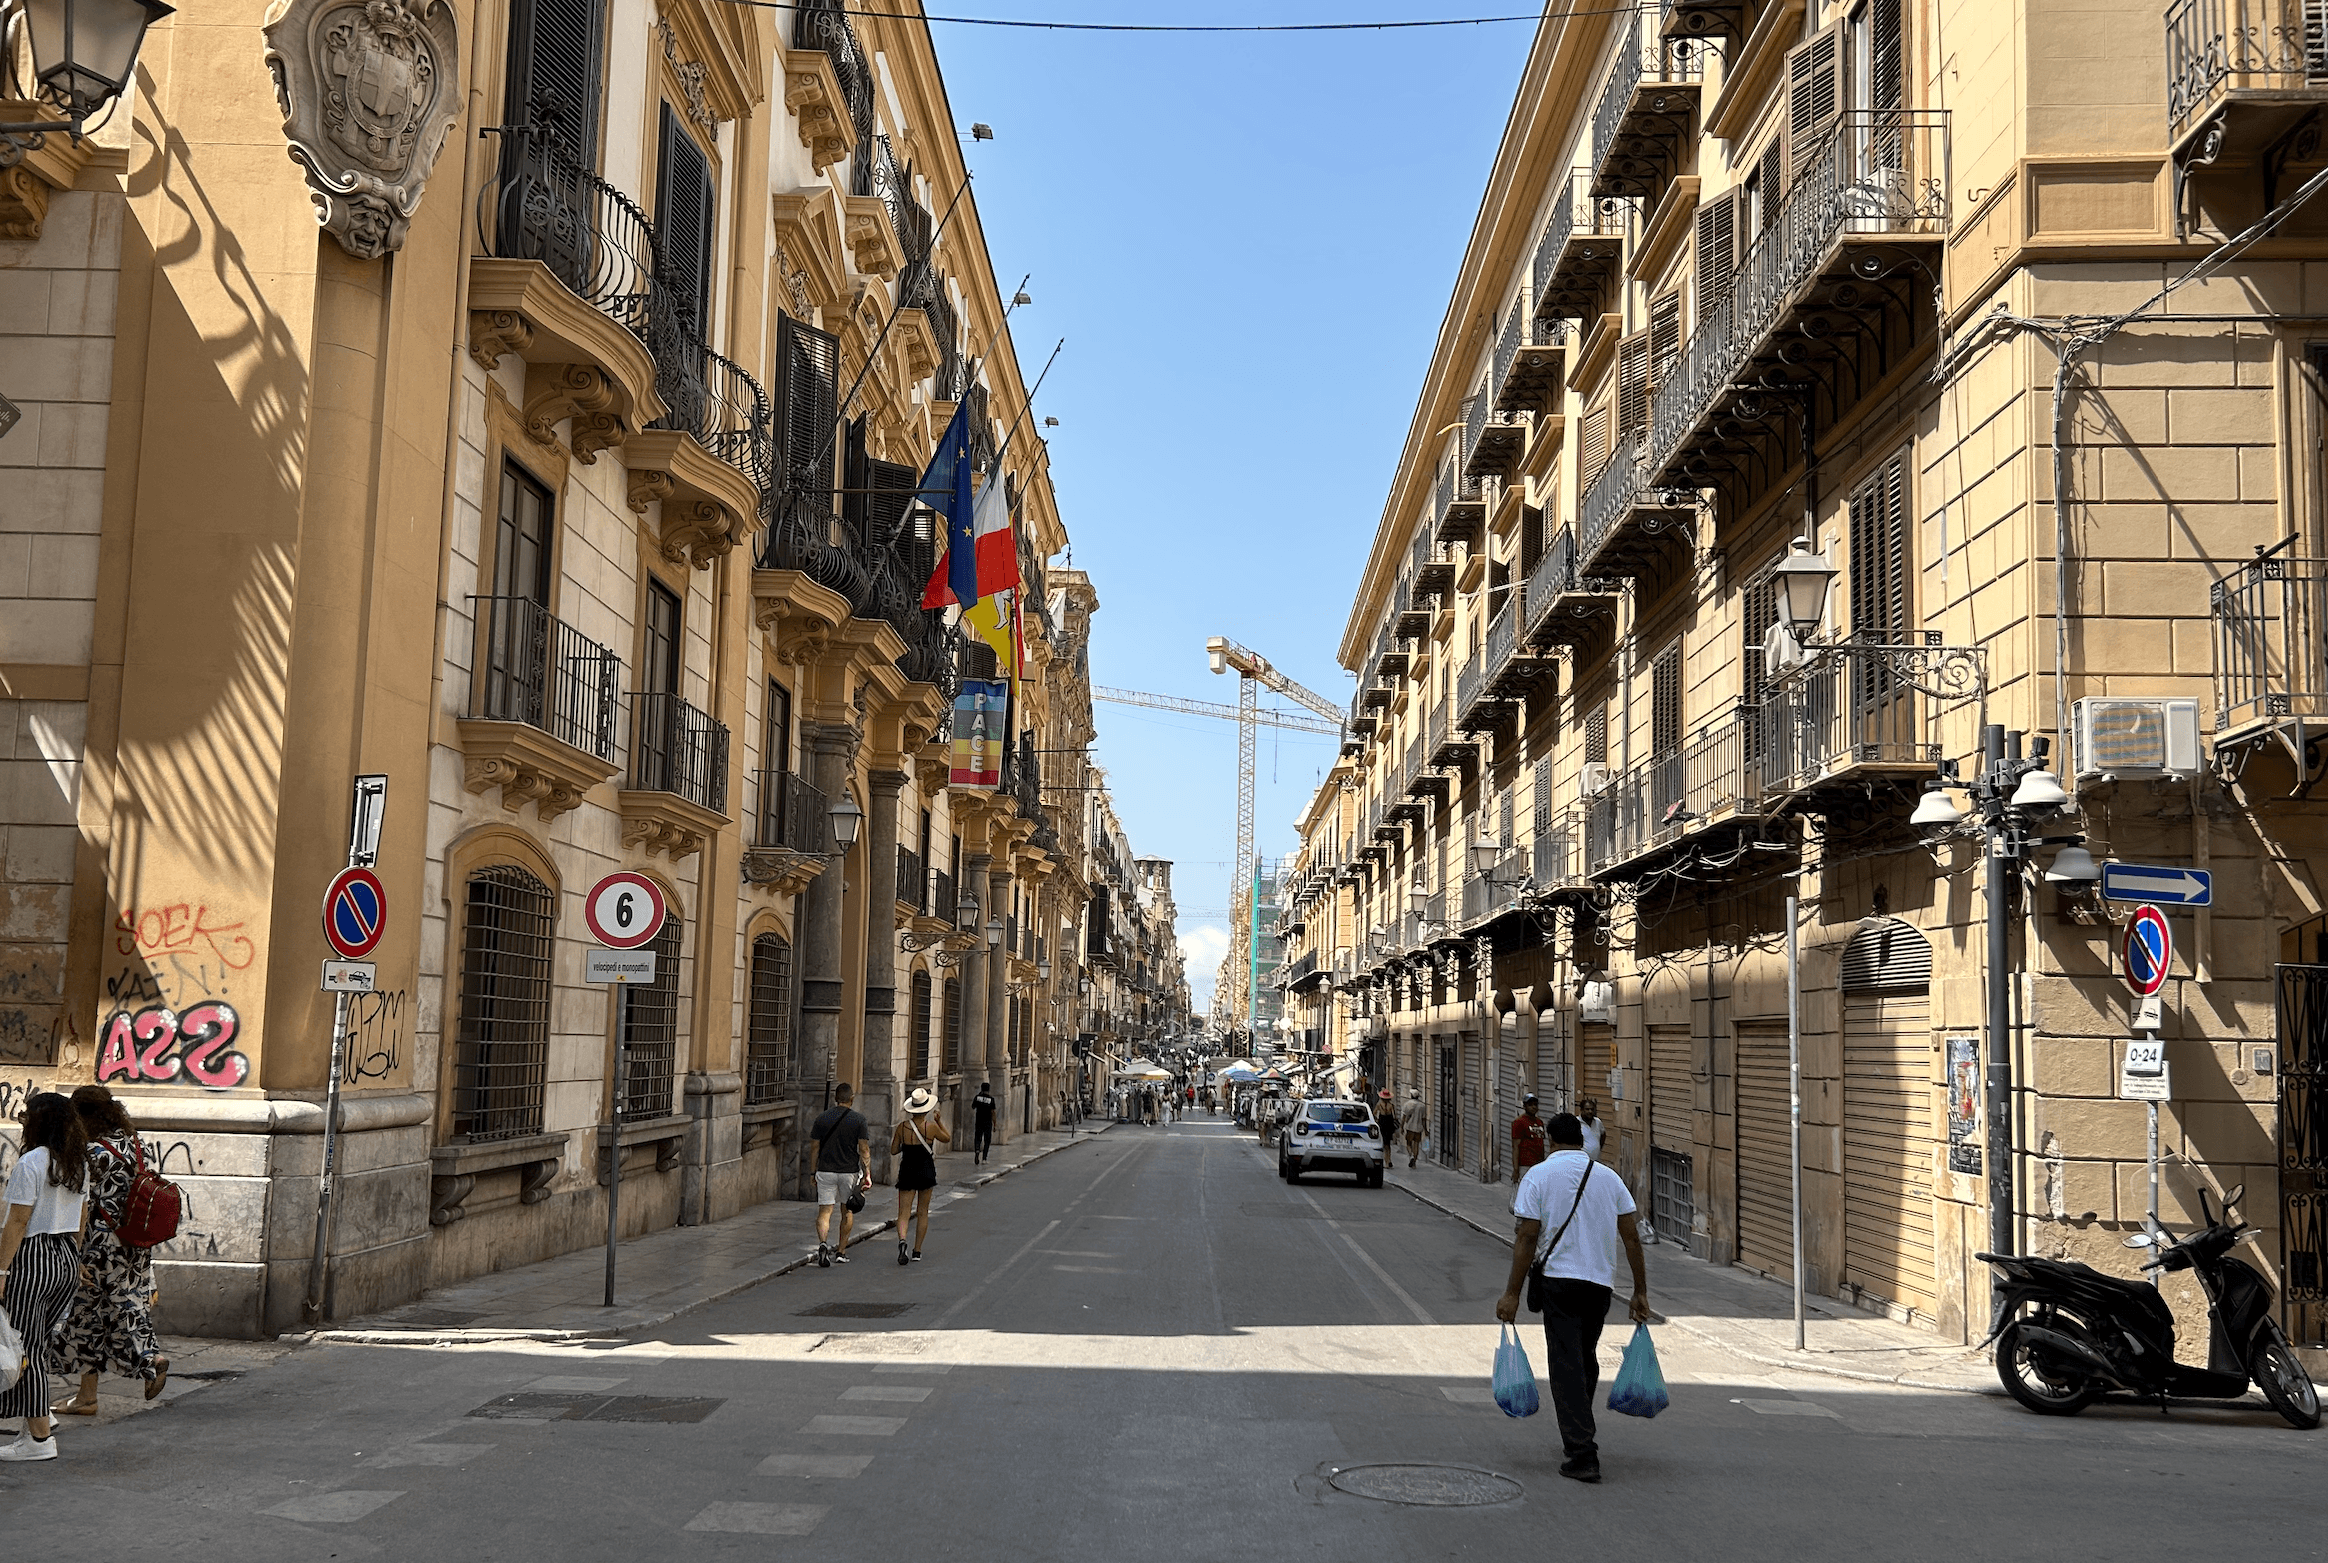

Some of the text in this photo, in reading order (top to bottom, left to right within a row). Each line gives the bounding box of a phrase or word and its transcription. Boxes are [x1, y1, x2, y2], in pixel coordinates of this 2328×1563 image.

[970, 693, 987, 773] PACE
[616, 892, 634, 928] 6
[593, 962, 650, 974] velocipedi e monopattini
[2130, 1048, 2157, 1062] 0-24
